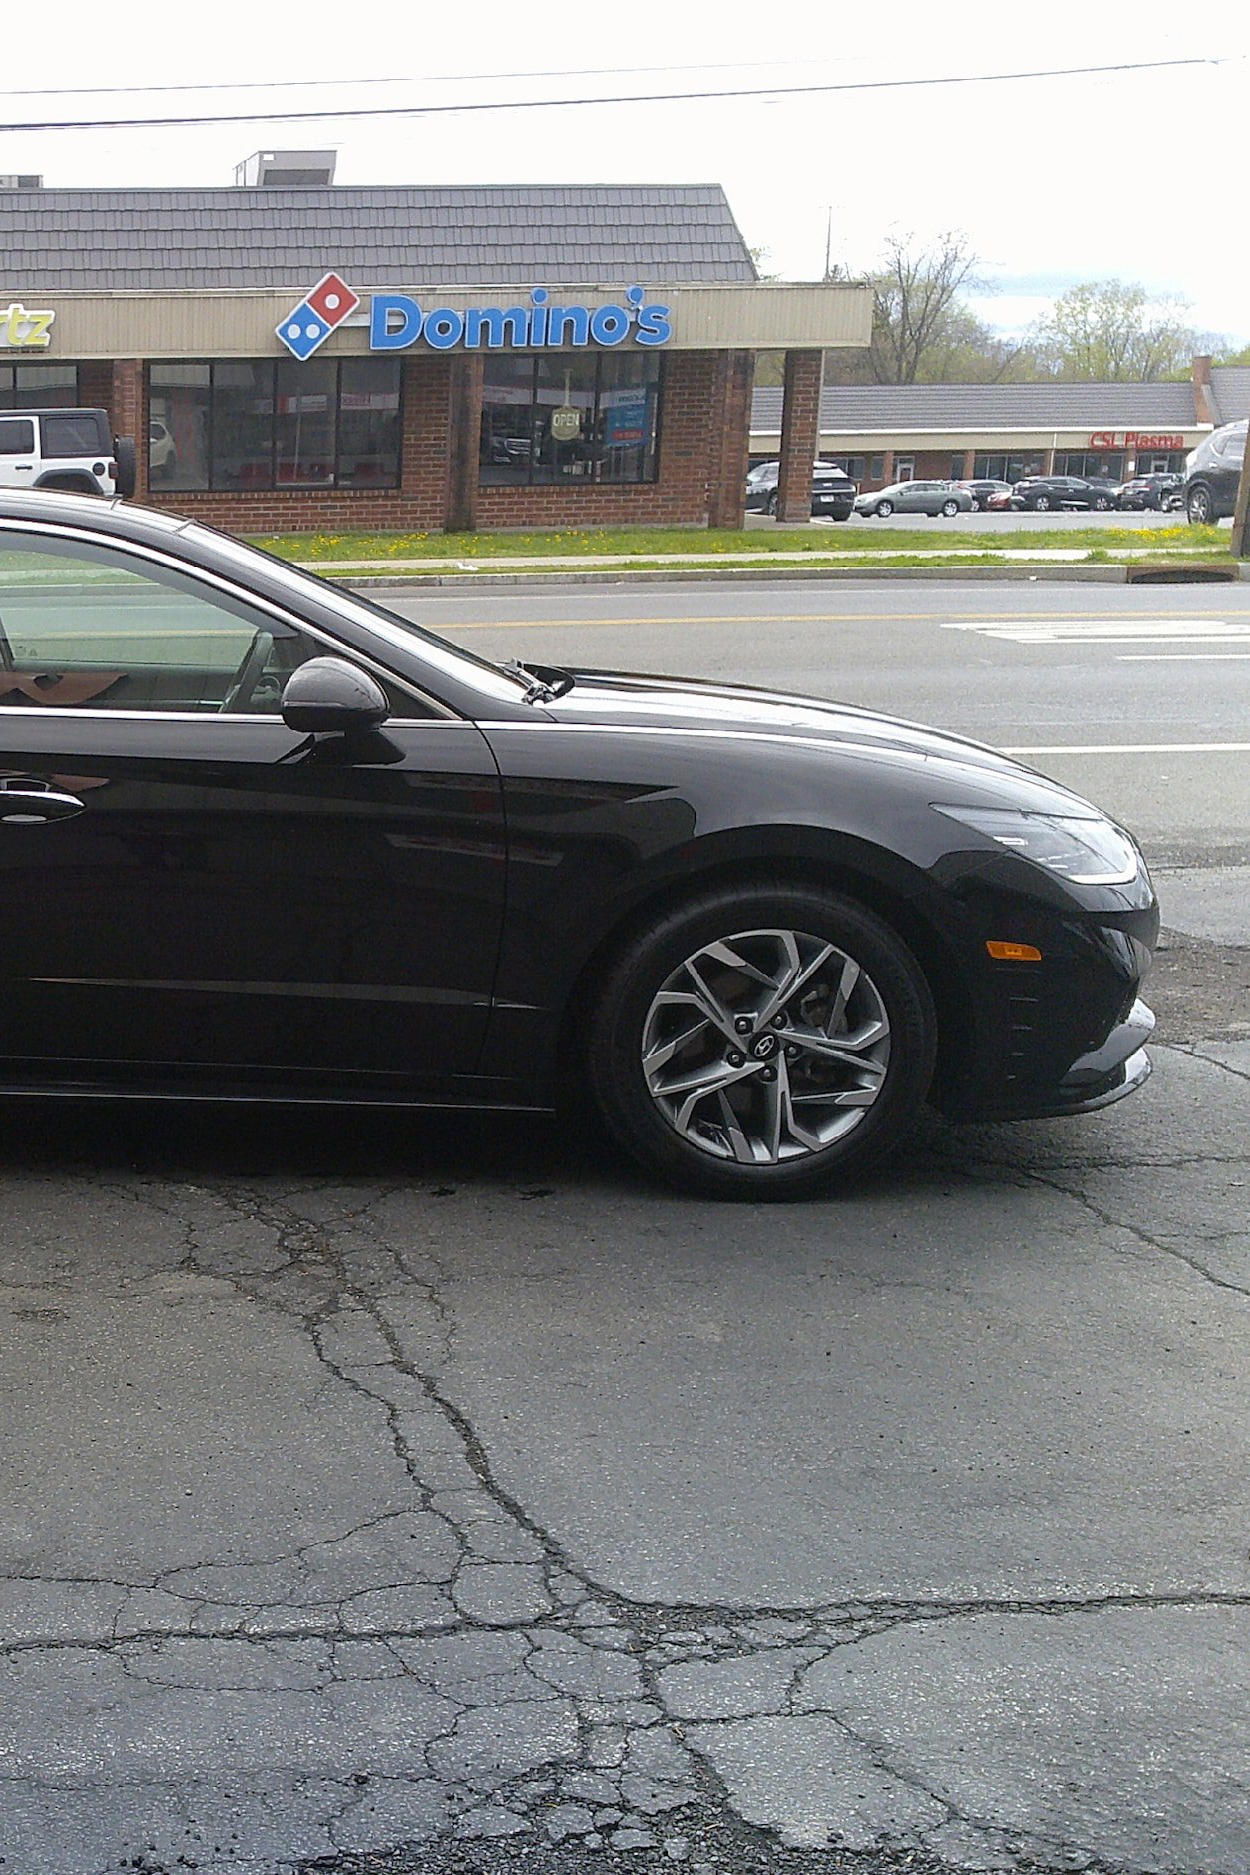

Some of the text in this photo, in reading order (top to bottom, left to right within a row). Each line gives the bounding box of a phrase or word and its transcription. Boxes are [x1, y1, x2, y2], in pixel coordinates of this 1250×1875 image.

[369, 286, 672, 350] Domino's
[553, 413, 580, 427] OPEN
[1090, 432, 1184, 449] CSL Plasma
